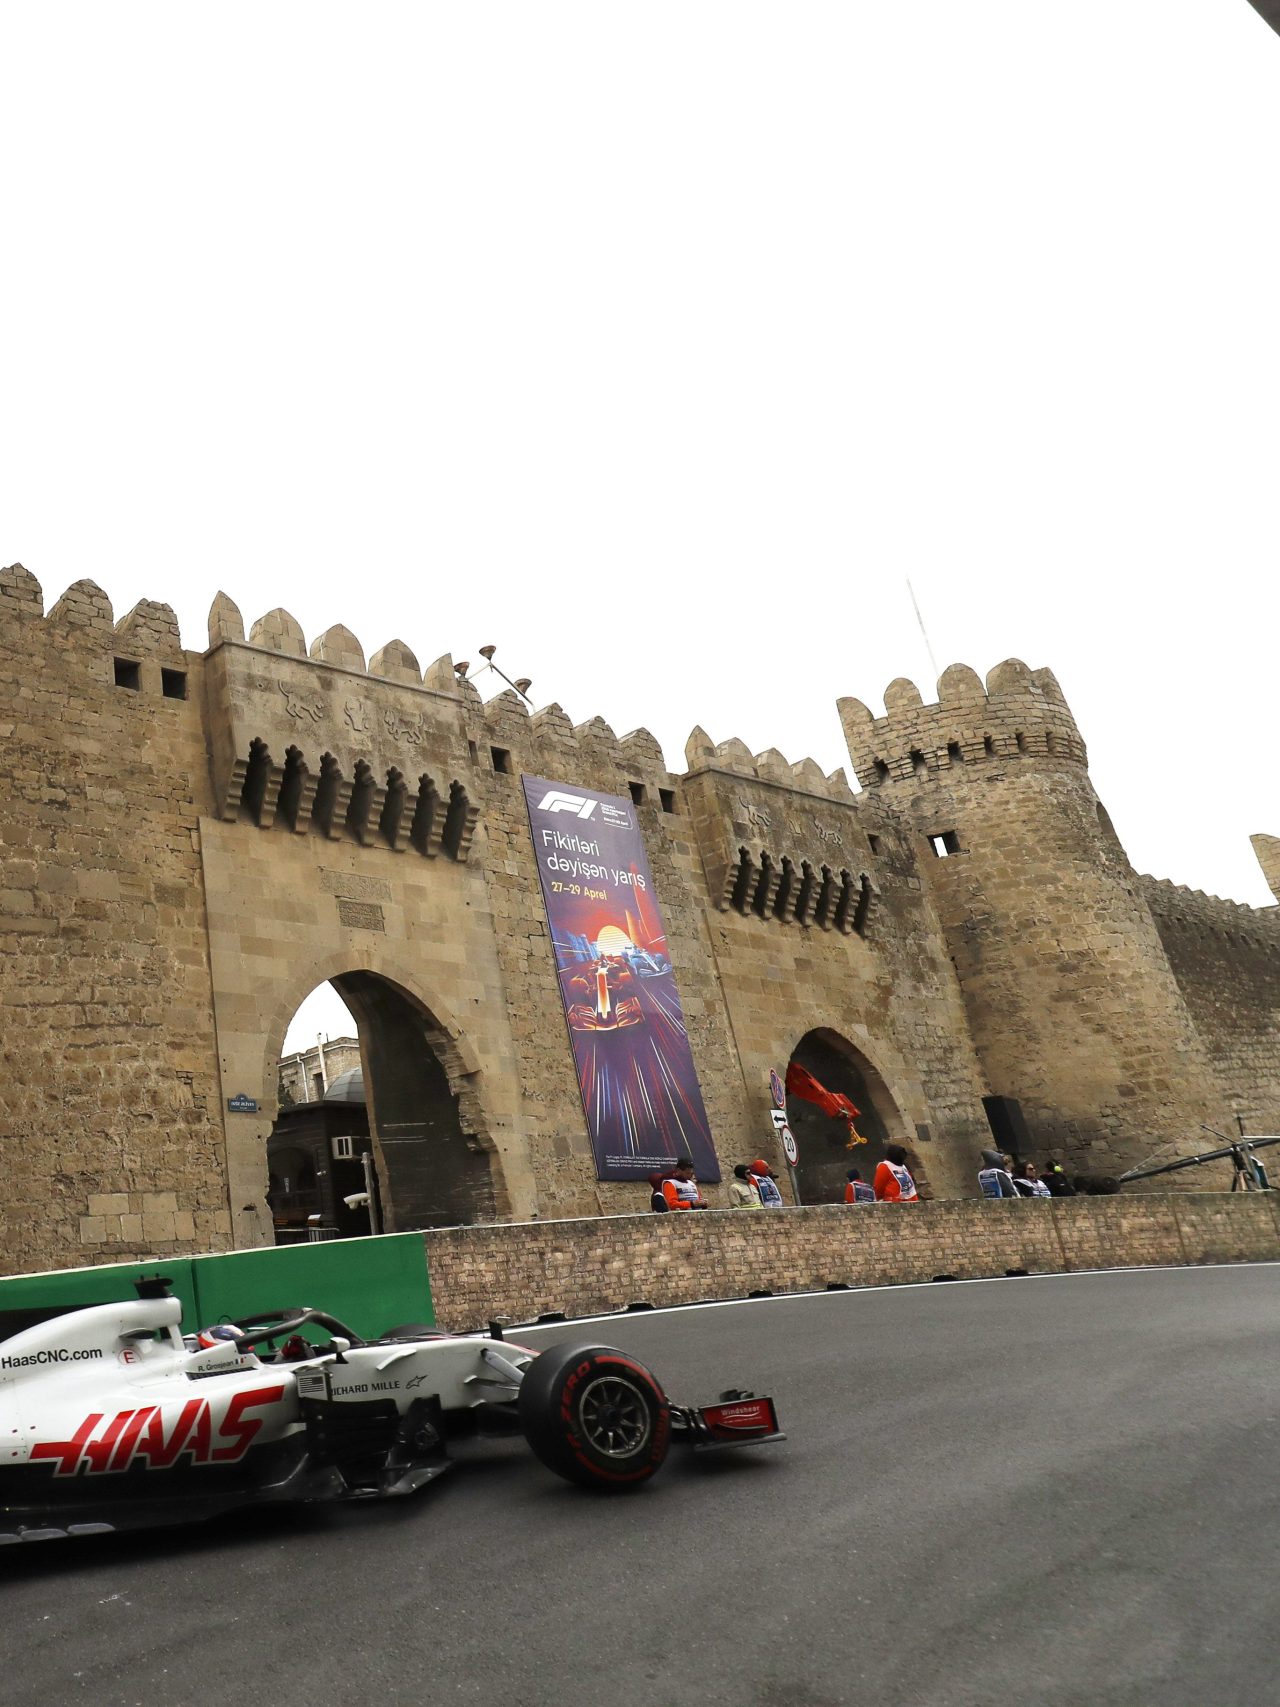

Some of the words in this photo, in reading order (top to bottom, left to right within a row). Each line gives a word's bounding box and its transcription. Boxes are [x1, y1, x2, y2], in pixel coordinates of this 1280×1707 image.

[542, 830, 600, 856] Fikirləri
[547, 852, 608, 879] dəyişən
[611, 868, 646, 891] yarış
[584, 886, 607, 900] Aprel
[785, 1136, 795, 1152] 20
[1, 1349, 103, 1369] HaasCNC.com
[124, 1351, 137, 1364] E
[331, 1383, 368, 1397] ICHARD
[371, 1380, 400, 1392] MILLE
[721, 1406, 760, 1416] Windshear
[29, 1385, 285, 1475] HAAS
